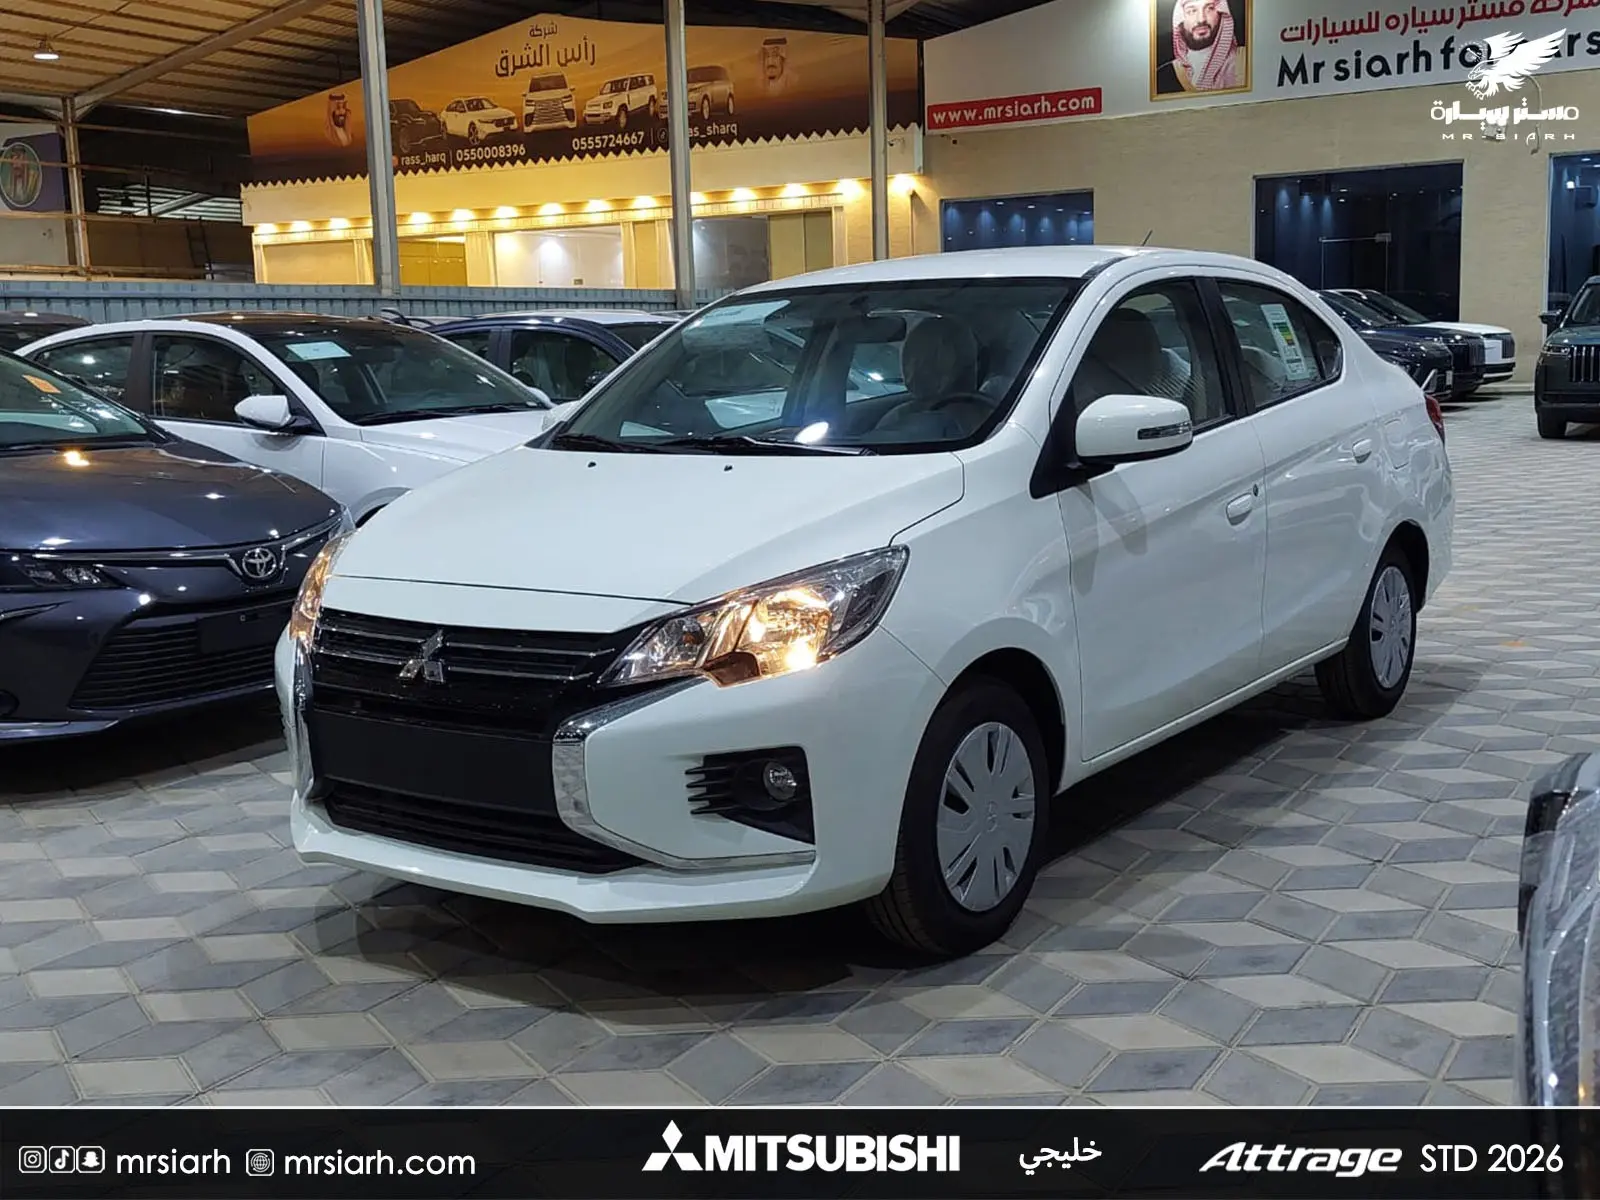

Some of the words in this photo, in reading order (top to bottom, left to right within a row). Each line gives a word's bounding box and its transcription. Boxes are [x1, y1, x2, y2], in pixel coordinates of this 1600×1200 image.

[529, 20, 558, 39] شركة
[1280, 11, 1380, 45] للسيارات
[495, 43, 550, 77] الشرق
[557, 35, 596, 67] رأس
[1276, 53, 1325, 87] Mr
[1333, 39, 1432, 82] siarh
[932, 95, 1095, 124] www.mrsiarh.com
[401, 151, 447, 166] rass_harq
[456, 143, 526, 162] 0550008396
[572, 131, 645, 150] 0555724667
